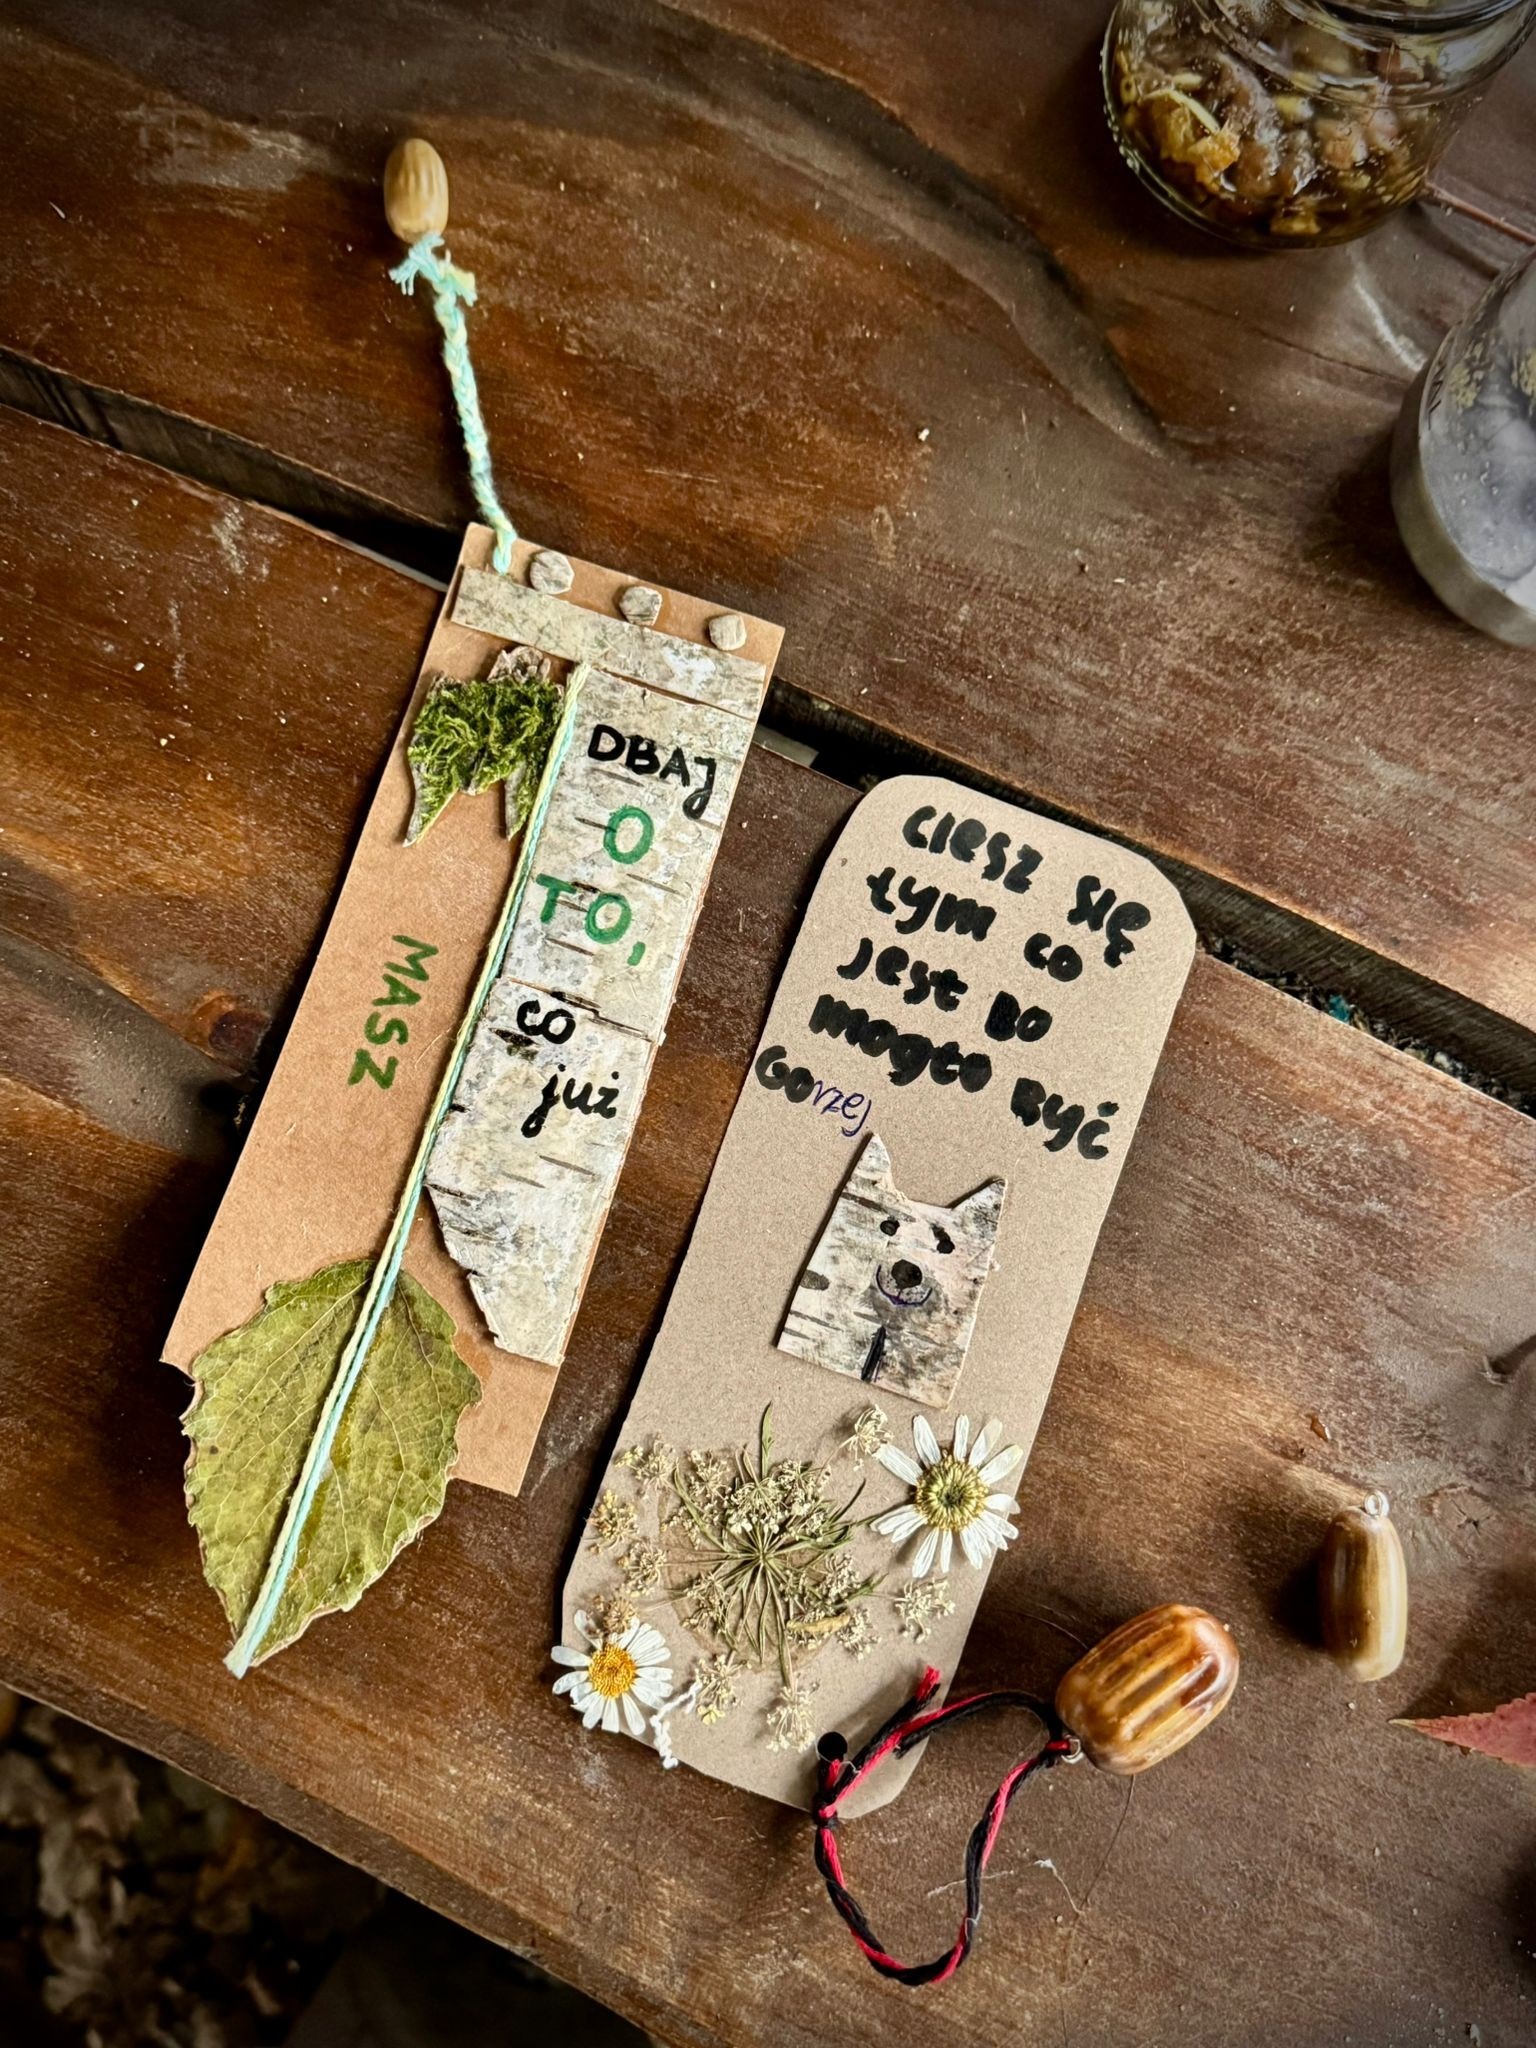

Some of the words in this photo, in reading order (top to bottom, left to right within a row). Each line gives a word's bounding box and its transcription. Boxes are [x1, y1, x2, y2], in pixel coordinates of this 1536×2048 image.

[587, 724, 717, 820] DBAJ
[603, 804, 655, 864] O
[536, 873, 646, 966] TO,
[866, 867, 997, 941] tym
[348, 935, 438, 1089] MASZ
[521, 1065, 620, 1138] już
